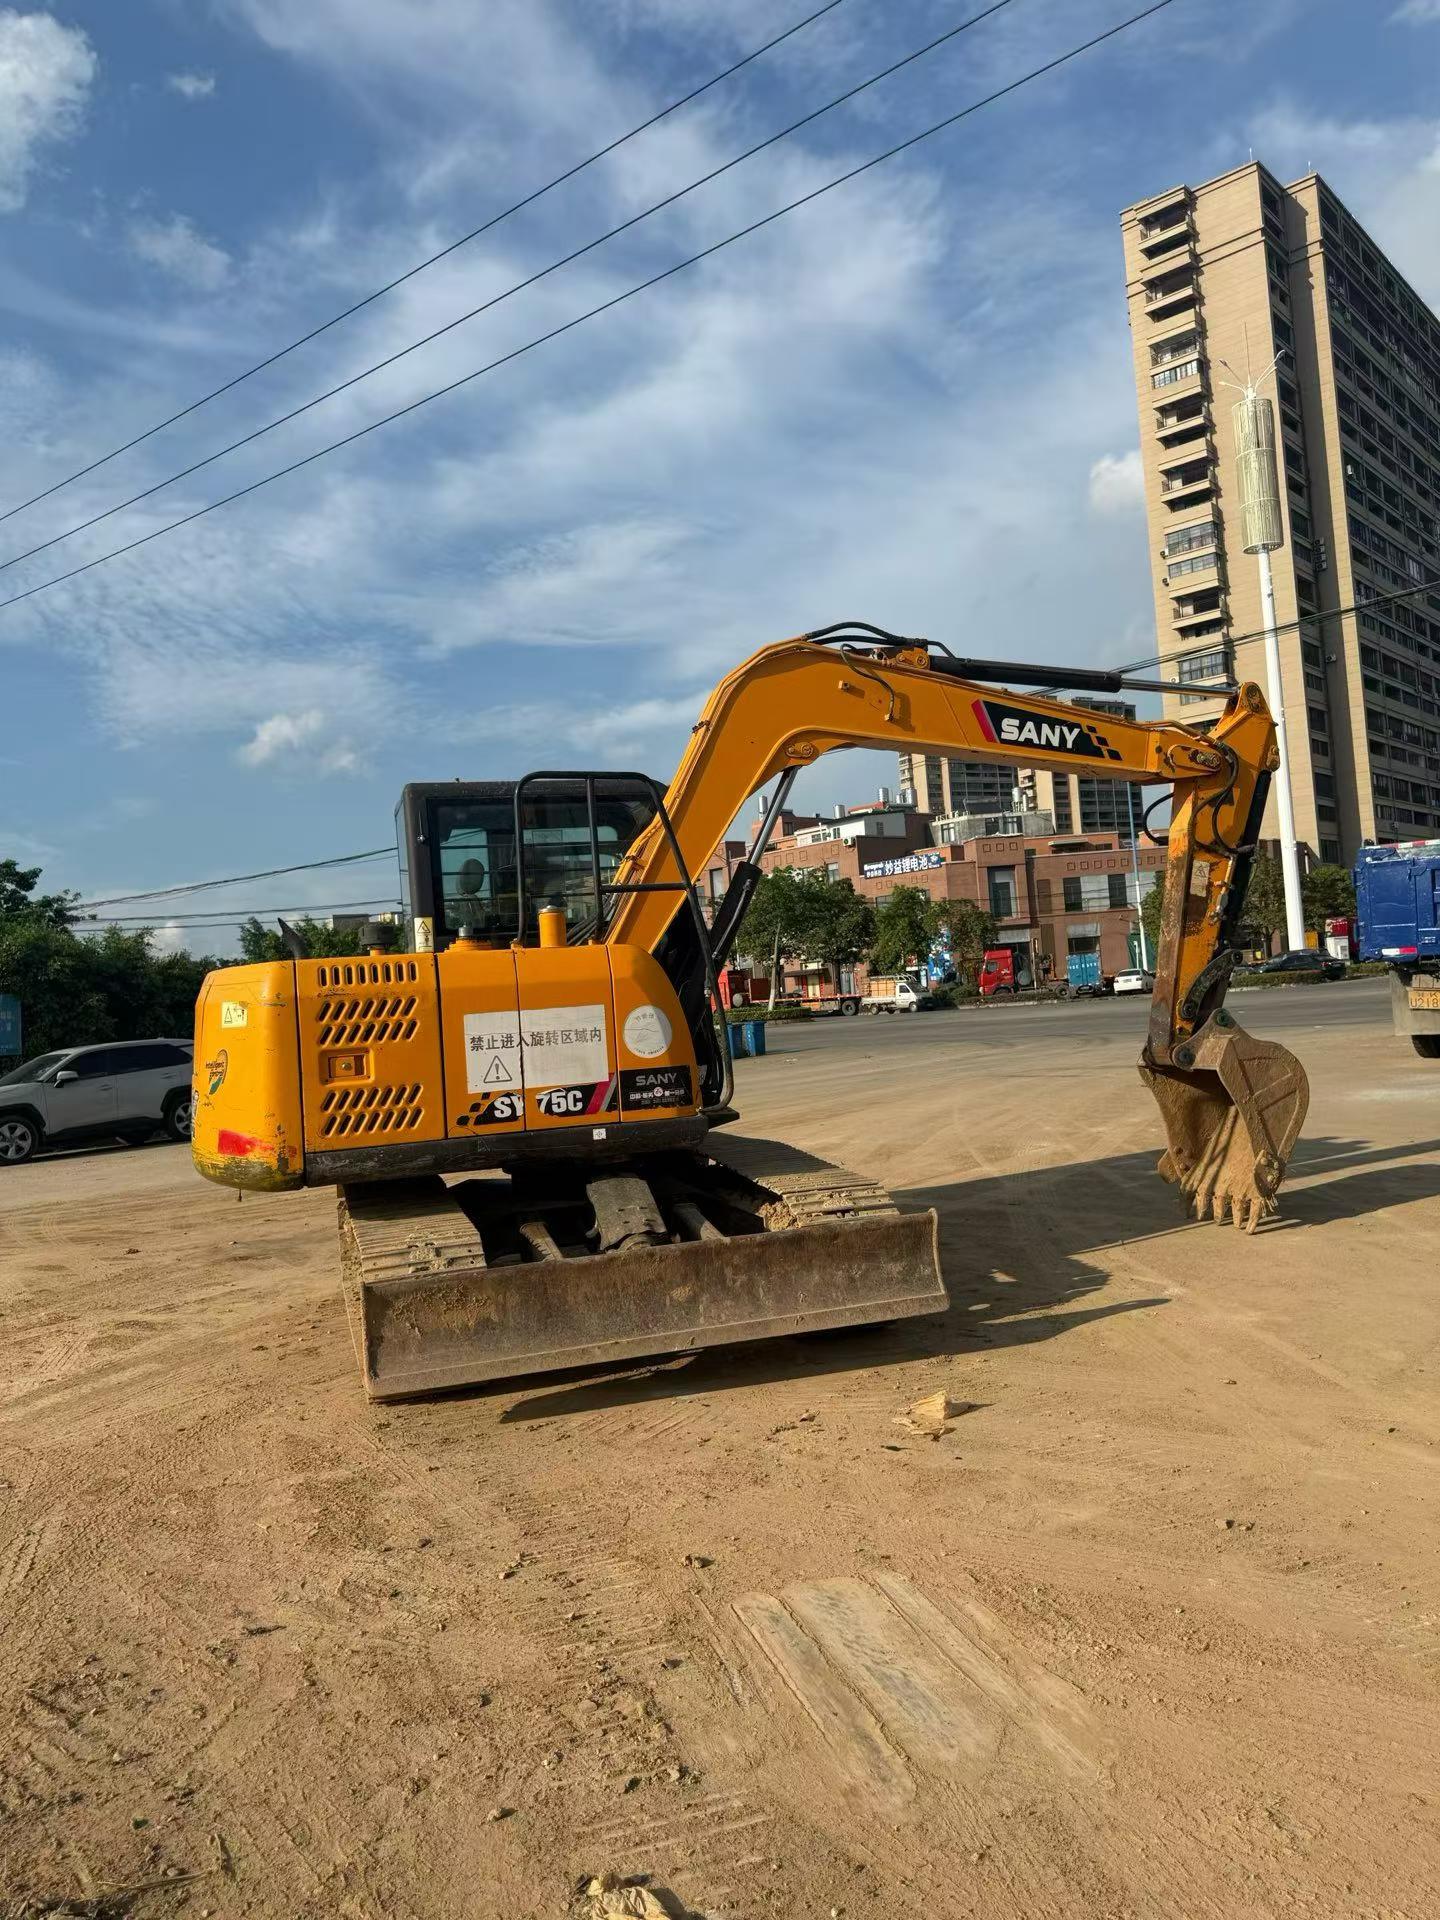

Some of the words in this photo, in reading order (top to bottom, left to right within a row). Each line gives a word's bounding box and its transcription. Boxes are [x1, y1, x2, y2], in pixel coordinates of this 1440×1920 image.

[1000, 717, 1081, 749] SANY
[470, 1027, 602, 1052] 禁止进入旋转区域内
[635, 1072, 677, 1086] SANY
